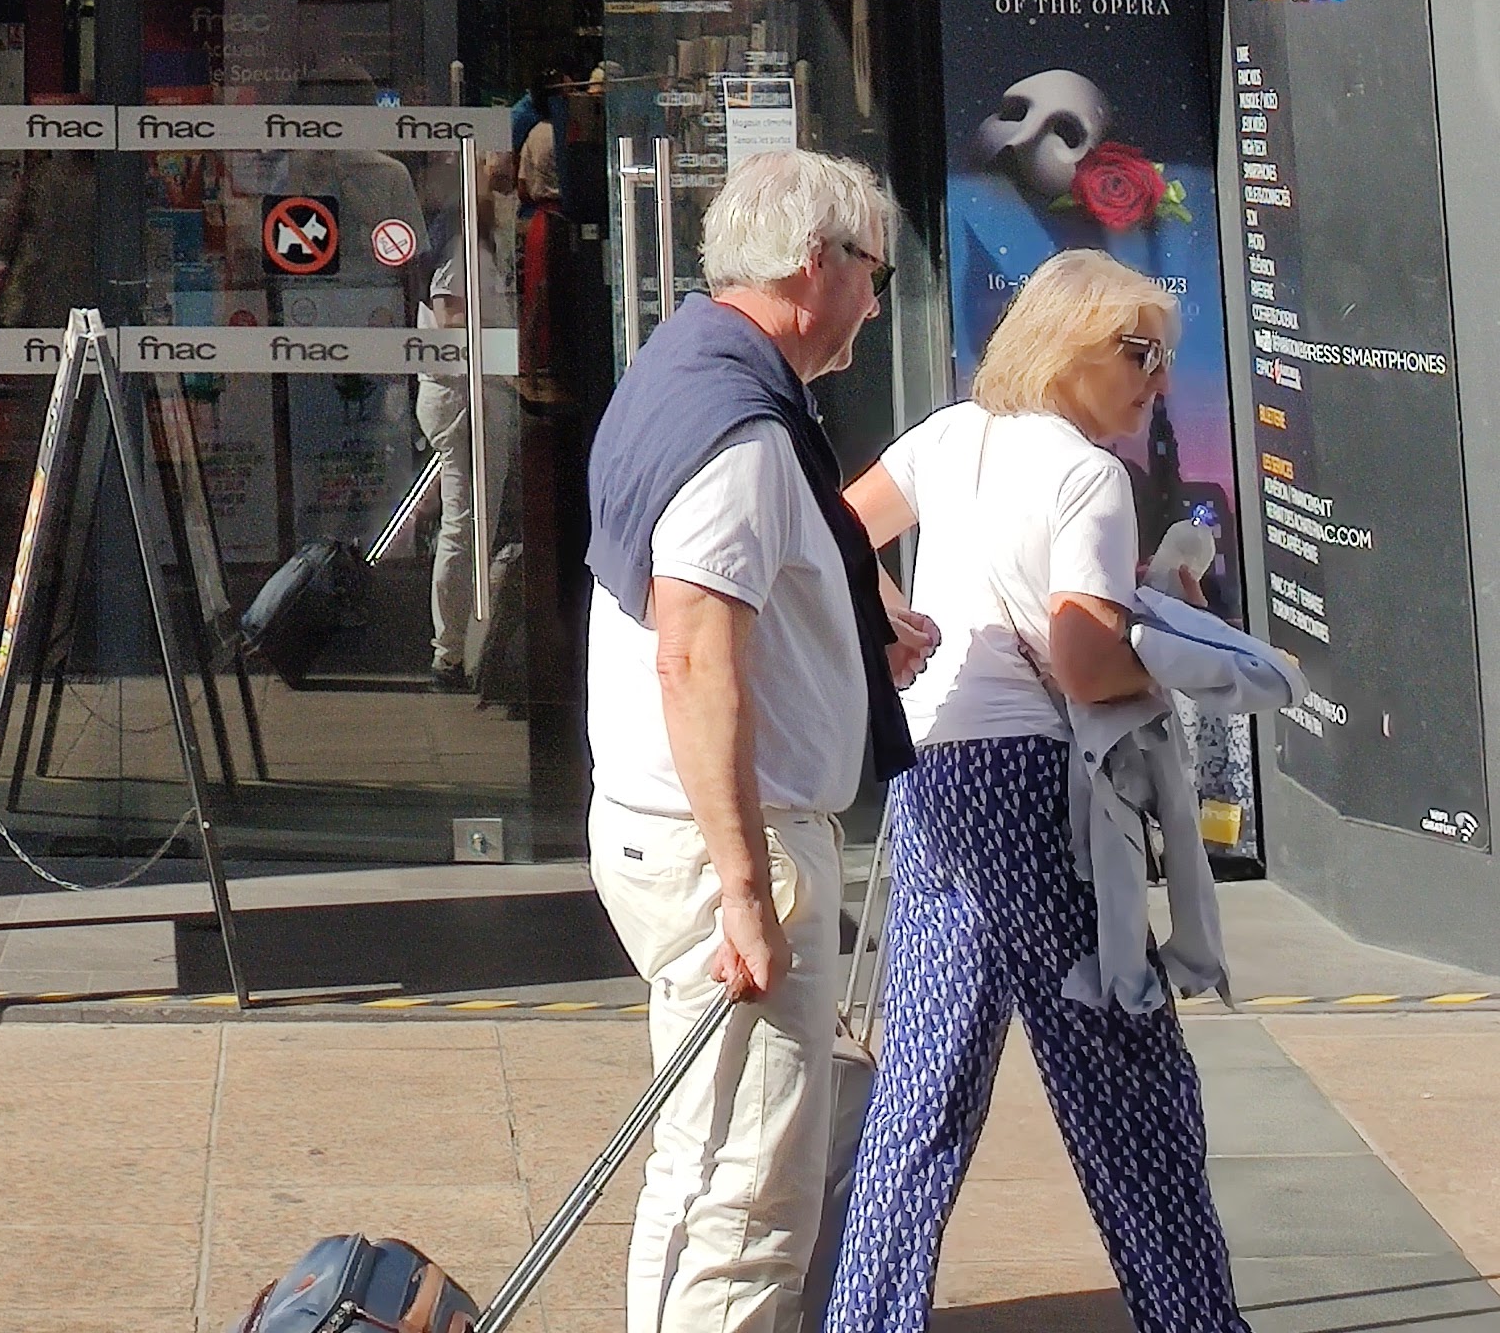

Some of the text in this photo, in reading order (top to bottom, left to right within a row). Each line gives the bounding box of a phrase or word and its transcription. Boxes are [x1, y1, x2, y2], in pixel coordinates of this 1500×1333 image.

[26, 114, 103, 138] fnac
[137, 114, 215, 139] fnac
[265, 114, 343, 138] fnac
[396, 115, 474, 139] fnac
[987, 273, 1030, 291] 16-3
[138, 335, 217, 361] fnac
[270, 335, 349, 362] fnac
[1343, 347, 1447, 374] SMARTPHONES
